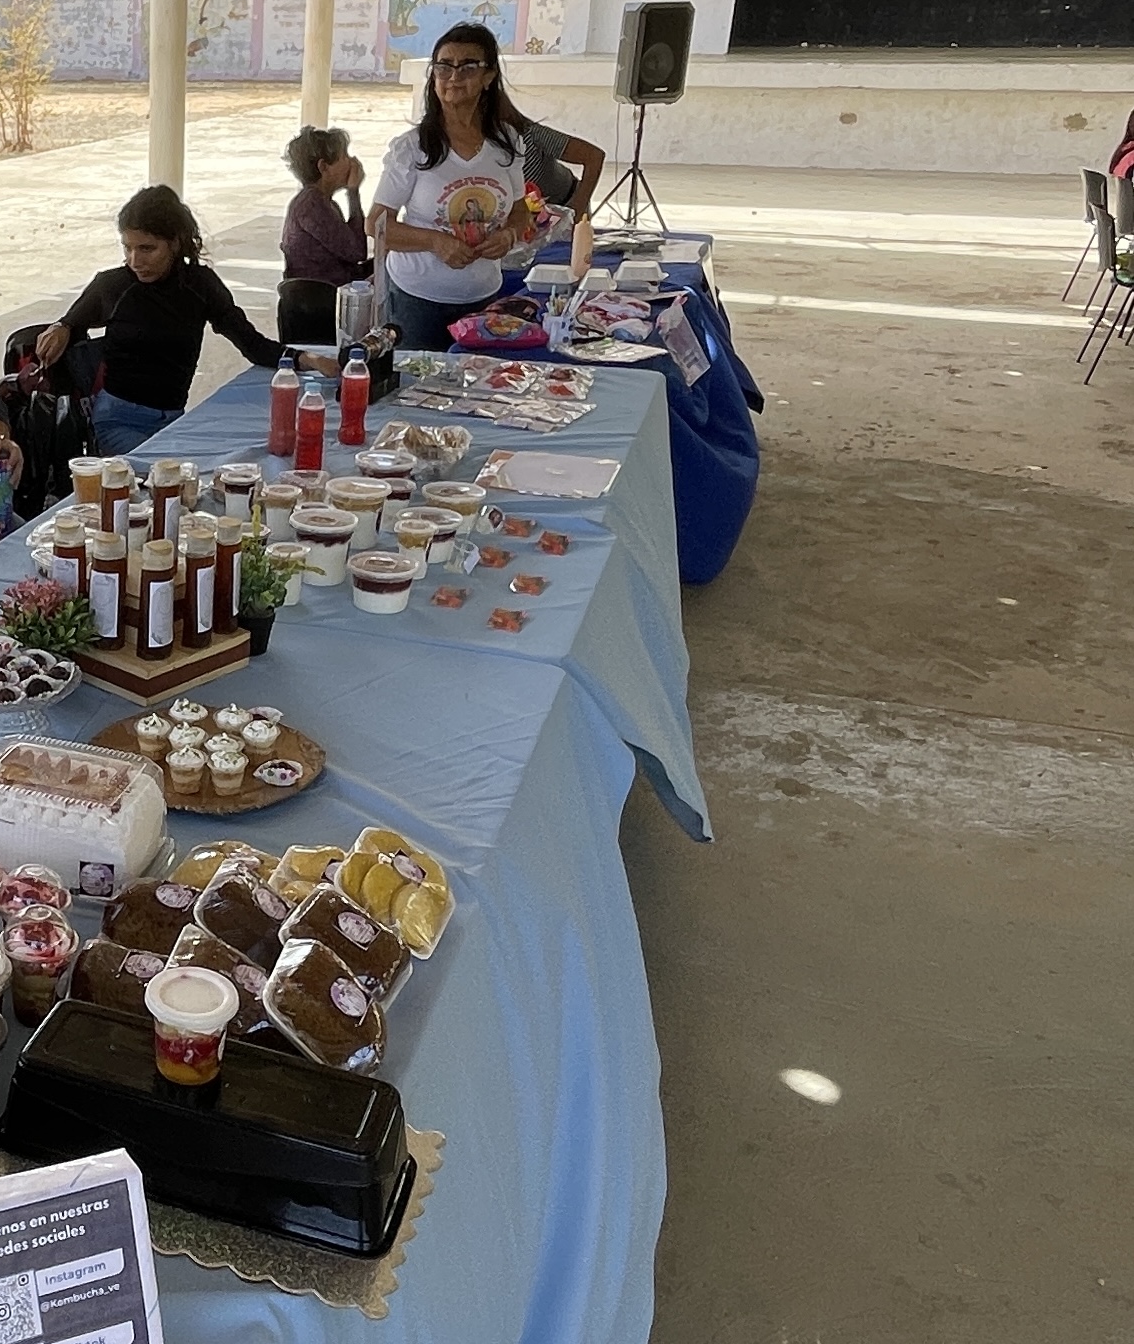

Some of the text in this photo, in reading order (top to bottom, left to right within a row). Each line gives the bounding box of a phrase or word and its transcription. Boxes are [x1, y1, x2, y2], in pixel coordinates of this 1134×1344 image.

[29, 1214, 47, 1229] en
[50, 1198, 110, 1223] nuestras
[31, 1224, 86, 1249] sociales
[44, 1260, 107, 1286] Instagram
